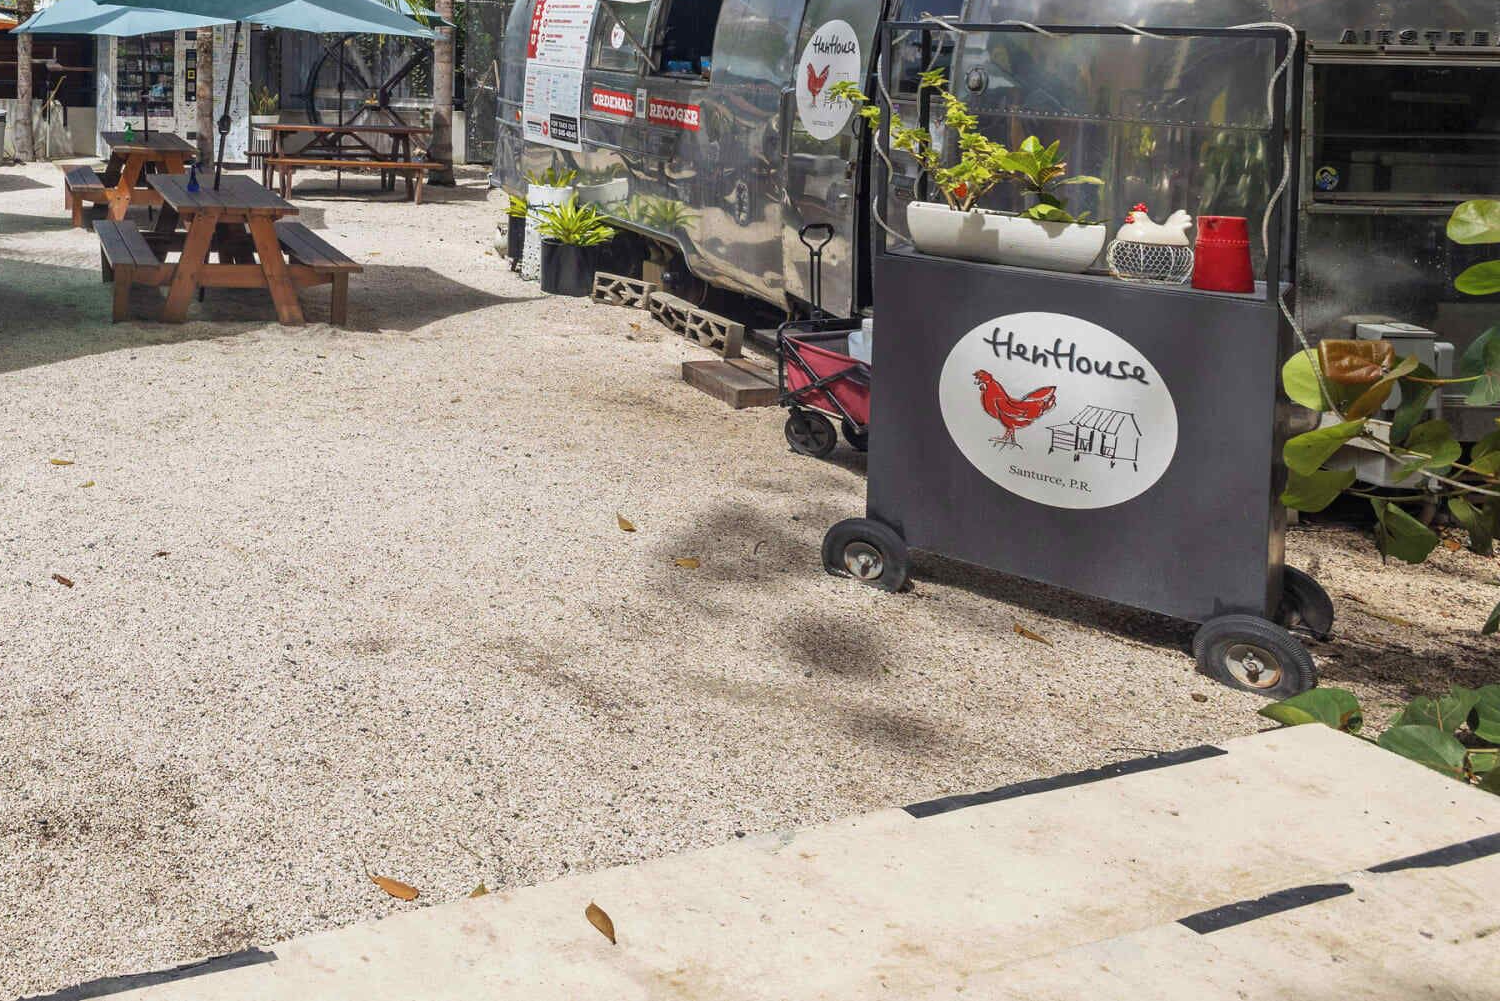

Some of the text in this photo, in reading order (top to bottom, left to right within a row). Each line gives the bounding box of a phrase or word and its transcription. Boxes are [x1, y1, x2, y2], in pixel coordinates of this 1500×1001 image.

[813, 34, 857, 55] HenHouse
[592, 93, 634, 112] ORDENAR
[649, 103, 699, 126] RECOGER
[983, 327, 1149, 385] HenHouse
[1008, 464, 1092, 493] Santurce, P.R.
